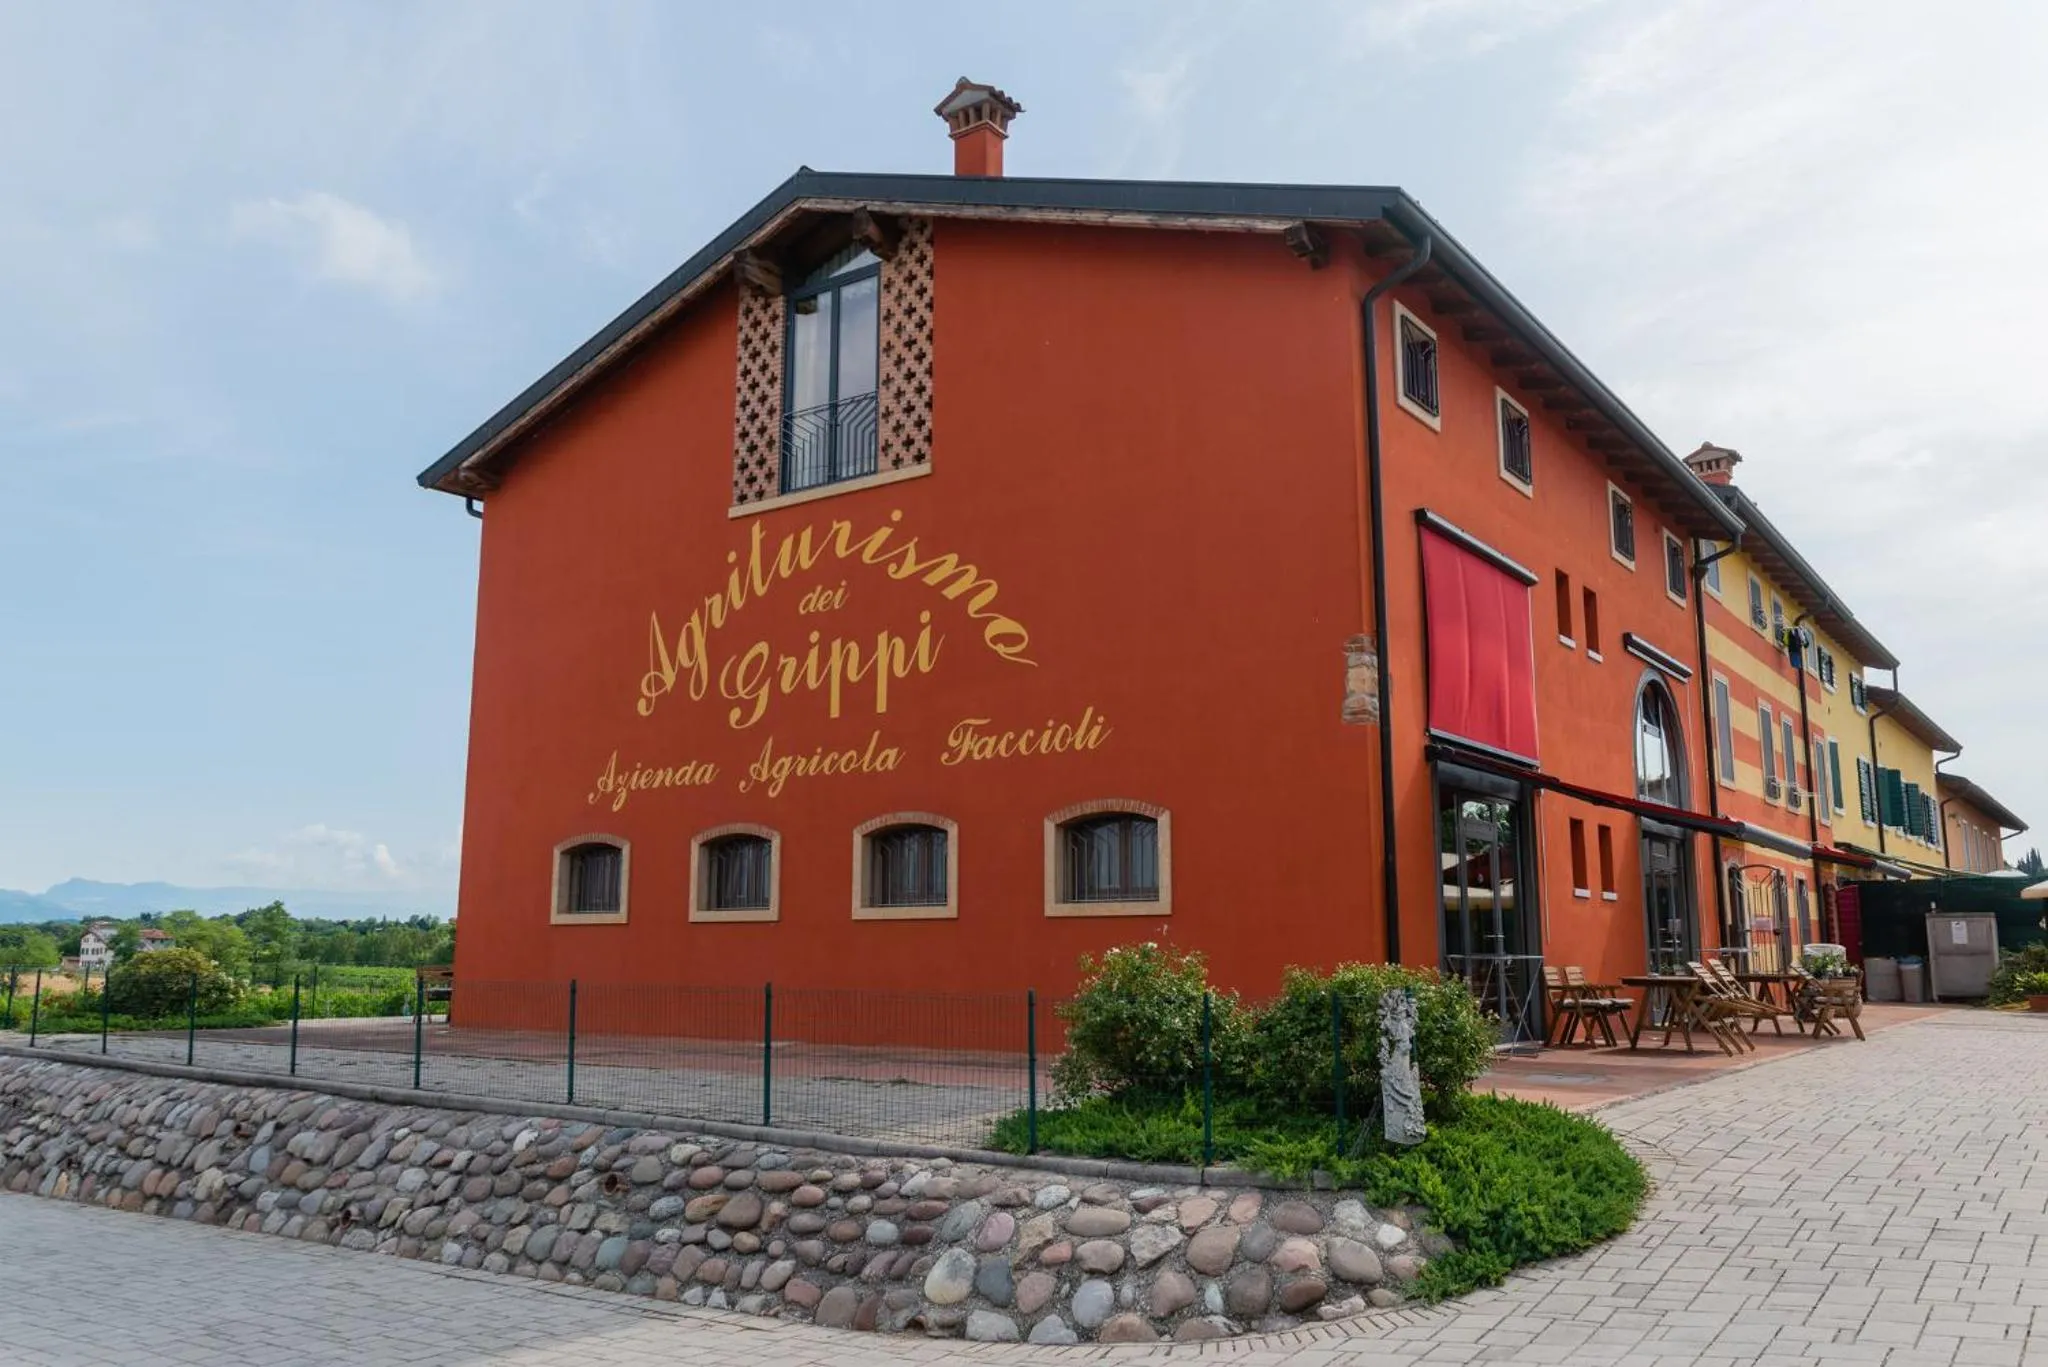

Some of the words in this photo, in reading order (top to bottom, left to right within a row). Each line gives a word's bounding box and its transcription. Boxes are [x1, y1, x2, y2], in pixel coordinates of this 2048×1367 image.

[637, 510, 1038, 716] Agriturismo
[798, 580, 848, 614] dei
[720, 610, 945, 729] Grippi
[588, 750, 720, 812] Azienda
[739, 730, 906, 797] Agricola
[941, 706, 1114, 766] Faccioli
